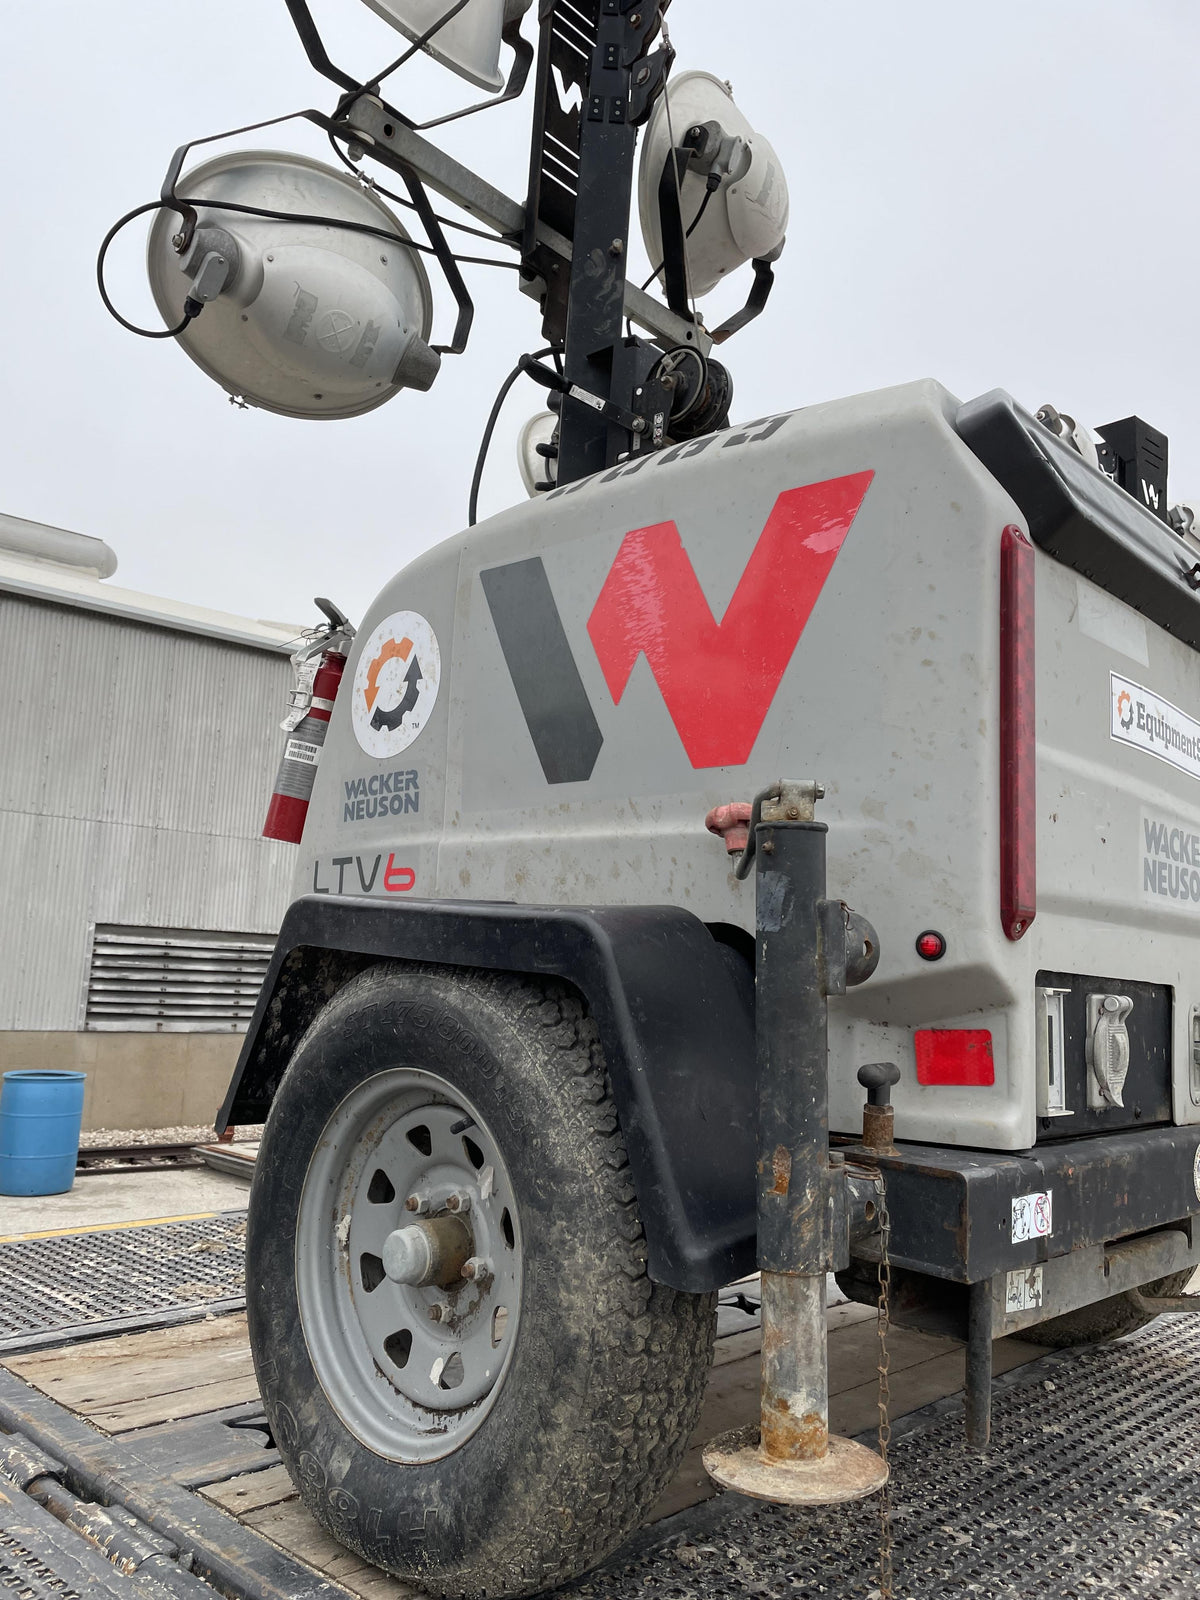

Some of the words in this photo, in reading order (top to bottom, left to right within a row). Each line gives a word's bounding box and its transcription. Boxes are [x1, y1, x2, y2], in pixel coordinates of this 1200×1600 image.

[344, 769, 420, 800] WACKER
[343, 791, 419, 822] NEUSON
[1143, 818, 1200, 868] WACKE
[313, 853, 416, 894] LTV6
[1143, 857, 1200, 903] NEUSO
